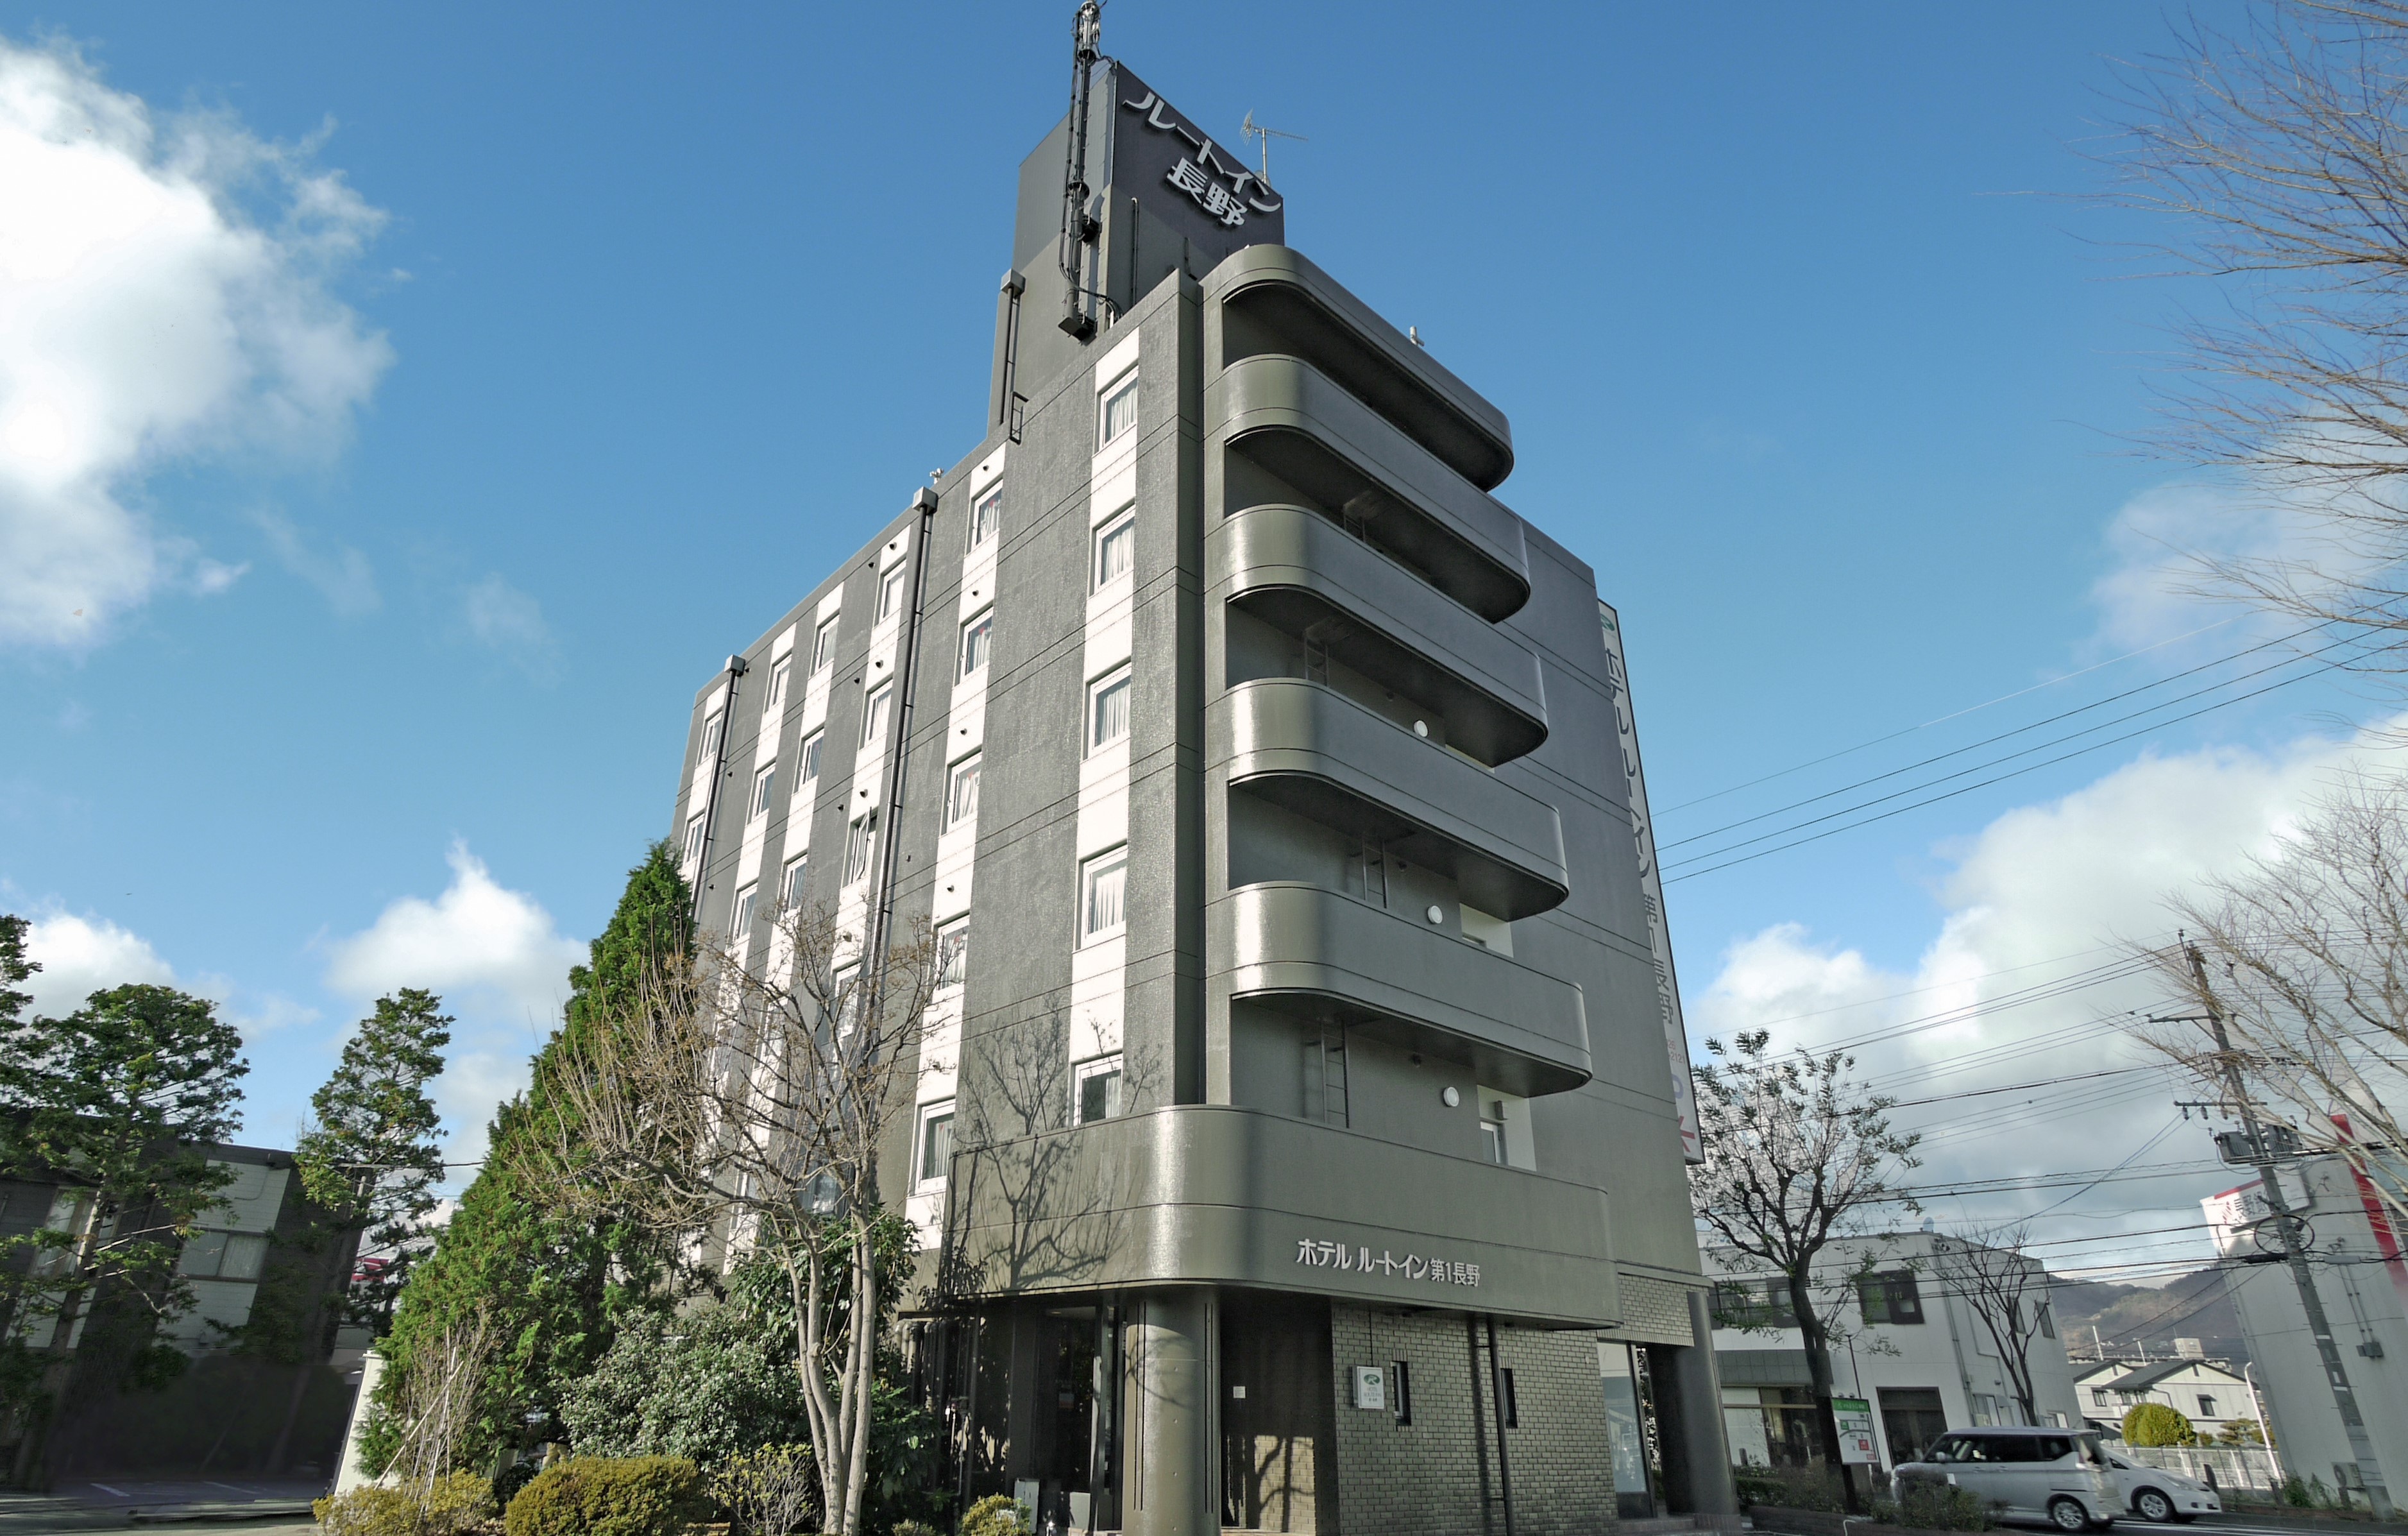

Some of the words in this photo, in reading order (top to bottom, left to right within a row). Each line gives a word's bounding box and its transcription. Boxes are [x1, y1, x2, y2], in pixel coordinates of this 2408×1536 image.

[1123, 91, 1281, 213] ルートイン
[1167, 157, 1248, 226] 長野
[1296, 1238, 1352, 1270] ホテル
